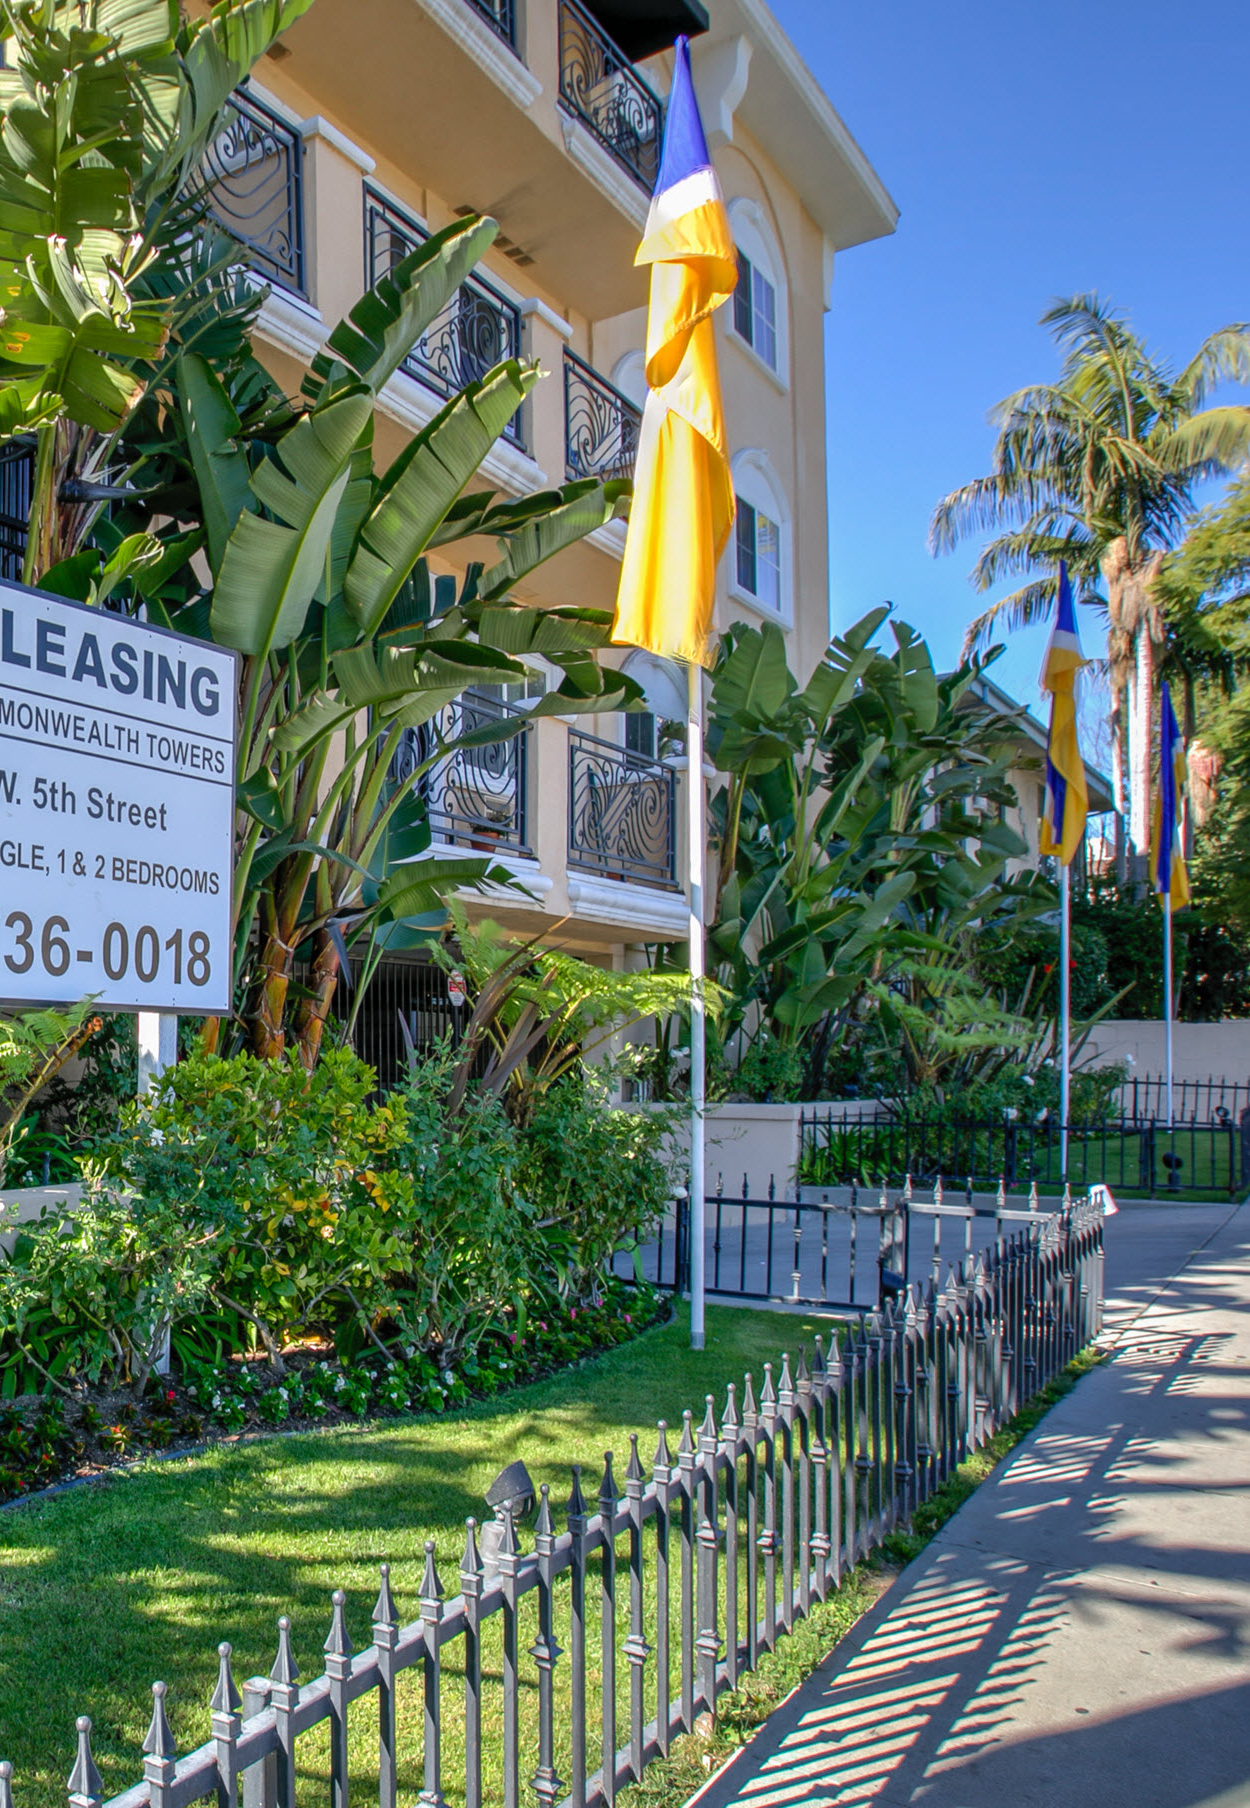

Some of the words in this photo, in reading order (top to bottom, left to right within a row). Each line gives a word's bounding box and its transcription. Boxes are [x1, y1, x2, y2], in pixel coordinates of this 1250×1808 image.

[2, 608, 219, 716] LEASING
[147, 733, 224, 773] TOWERS
[33, 777, 75, 814] 5th
[87, 788, 166, 831] Street
[57, 848, 66, 874] 1
[72, 850, 87, 877] &
[94, 854, 106, 880] 2
[112, 857, 219, 895] BEDROOMS
